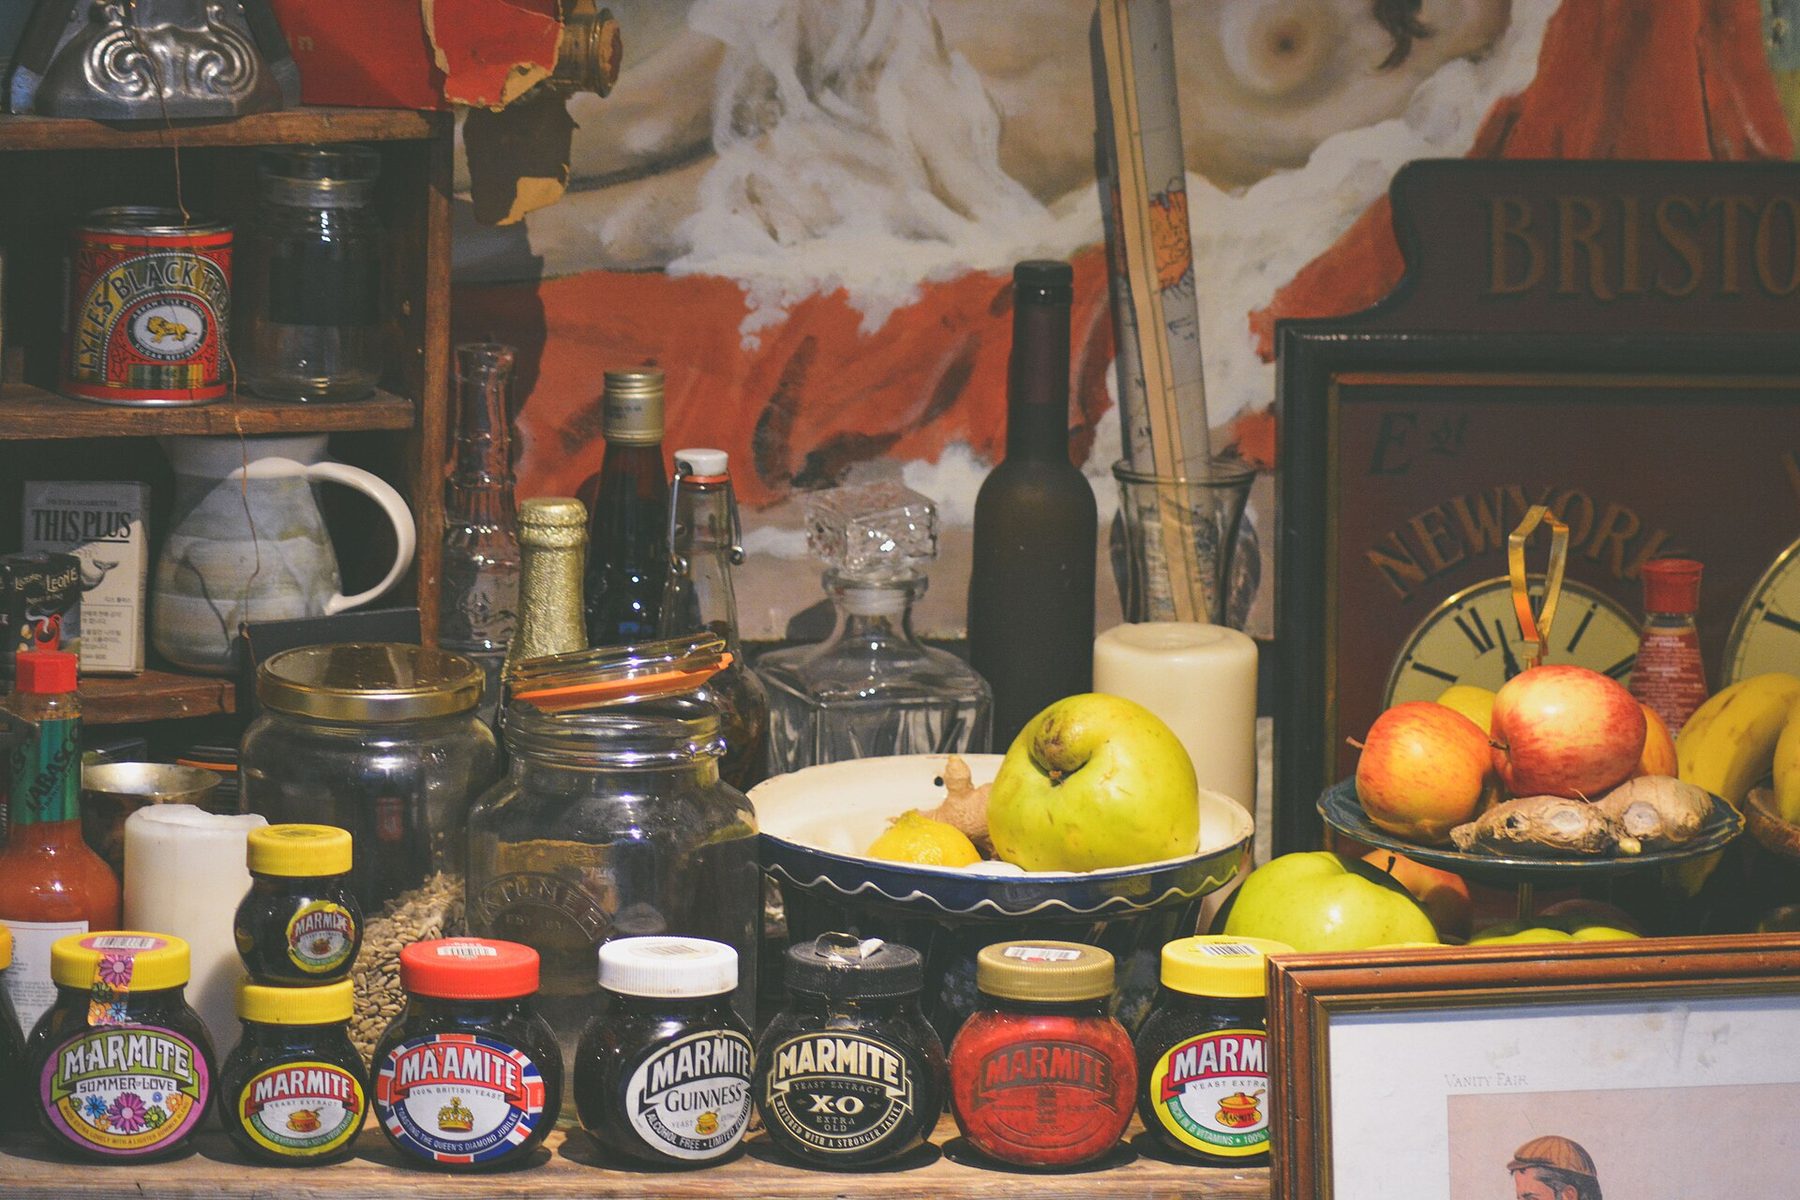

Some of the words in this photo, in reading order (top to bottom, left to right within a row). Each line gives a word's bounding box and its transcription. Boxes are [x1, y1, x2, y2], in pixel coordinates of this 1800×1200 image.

[110, 260, 199, 302] BLACK
[32, 509, 80, 542] THIS
[82, 511, 131, 538] PLUS
[295, 912, 348, 937] MARMITE
[64, 1034, 189, 1080] MARMITE
[401, 1046, 518, 1091] MA'AMITE
[651, 1038, 750, 1094] MARMITE
[778, 1038, 899, 1085] MARMITE
[985, 1046, 1106, 1088] MARMITE
[79, 1078, 136, 1093] SUMMER
[142, 1078, 173, 1091] LOVE
[255, 1070, 350, 1102] MARMITE
[412, 1088, 433, 1096] 100%
[436, 1086, 471, 1095] BRITISH
[475, 1089, 503, 1101] YEAST
[794, 1080, 826, 1091] YEAST
[830, 1080, 881, 1095] EXTRACT
[1192, 1080, 1226, 1090] YEAST
[1444, 1072, 1493, 1088] VANITY
[1496, 1072, 1529, 1086] FAIR
[269, 1100, 296, 1109] YEAST
[664, 1083, 742, 1112] GUINNESS
[420, 1132, 433, 1146] THE
[433, 1140, 463, 1152] QUEEN'S
[464, 1134, 497, 1151] DIAMOND
[497, 1111, 520, 1138] JUBILEE
[647, 1112, 678, 1144] ALCOHOL
[679, 1137, 701, 1150] FREE
[707, 1126, 737, 1149] LIMITED
[803, 1130, 825, 1146] WITH
[837, 1128, 882, 1148] STRONGER
[882, 1107, 901, 1130] TASTE
[816, 1115, 855, 1125] EXTRA
[823, 1124, 848, 1132] OLD
